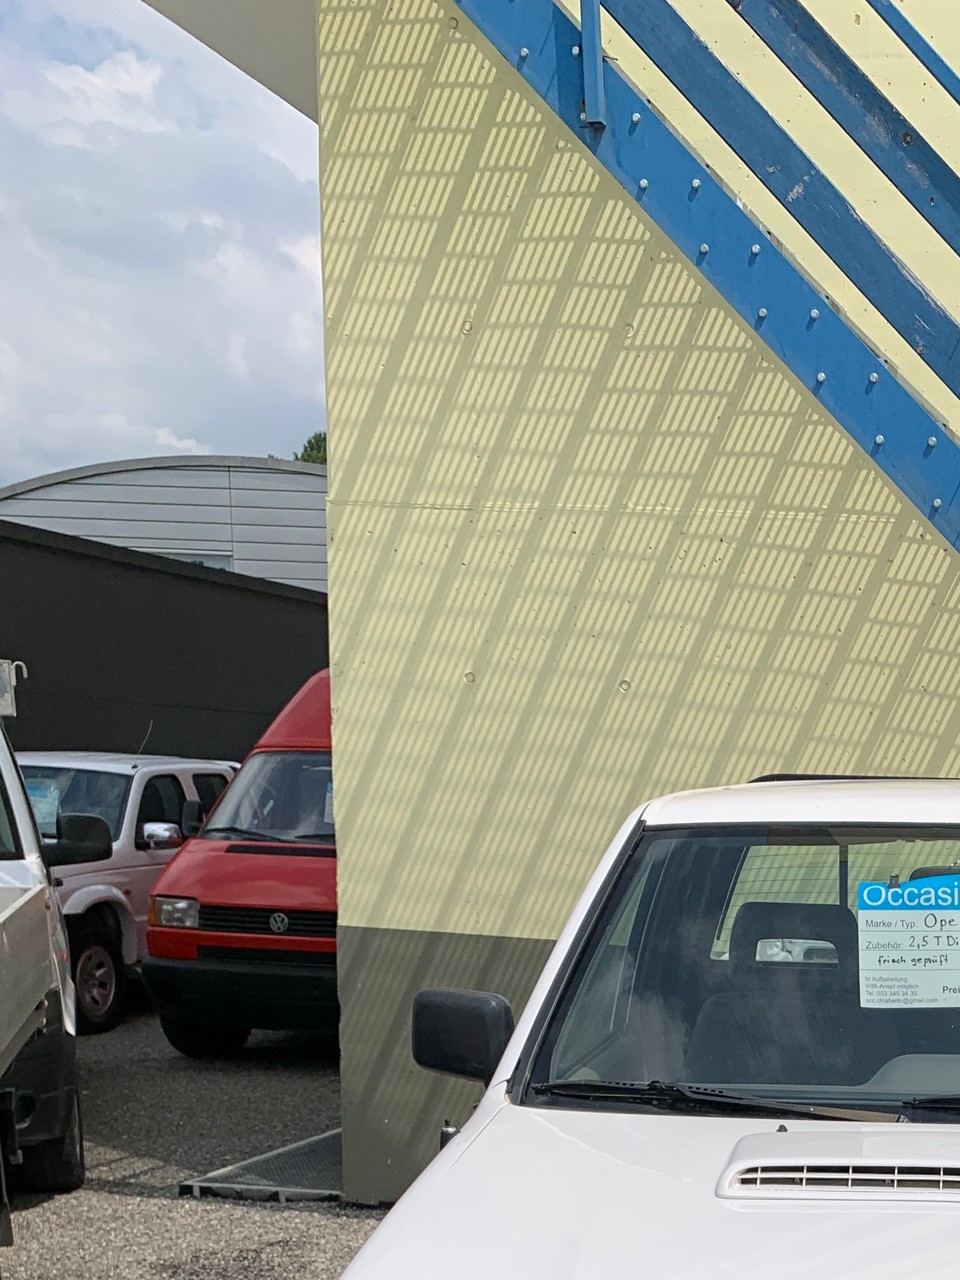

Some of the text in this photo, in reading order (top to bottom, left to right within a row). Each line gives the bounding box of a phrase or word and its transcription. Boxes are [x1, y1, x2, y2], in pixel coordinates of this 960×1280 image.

[865, 919, 892, 928] Marke
[900, 919, 918, 930] Typ:
[865, 940, 904, 950] Zubehör:
[908, 935, 929, 949] 2,5
[933, 935, 942, 946] T
[877, 953, 948, 968] frisch geprüft
[896, 983, 919, 991] möglich
